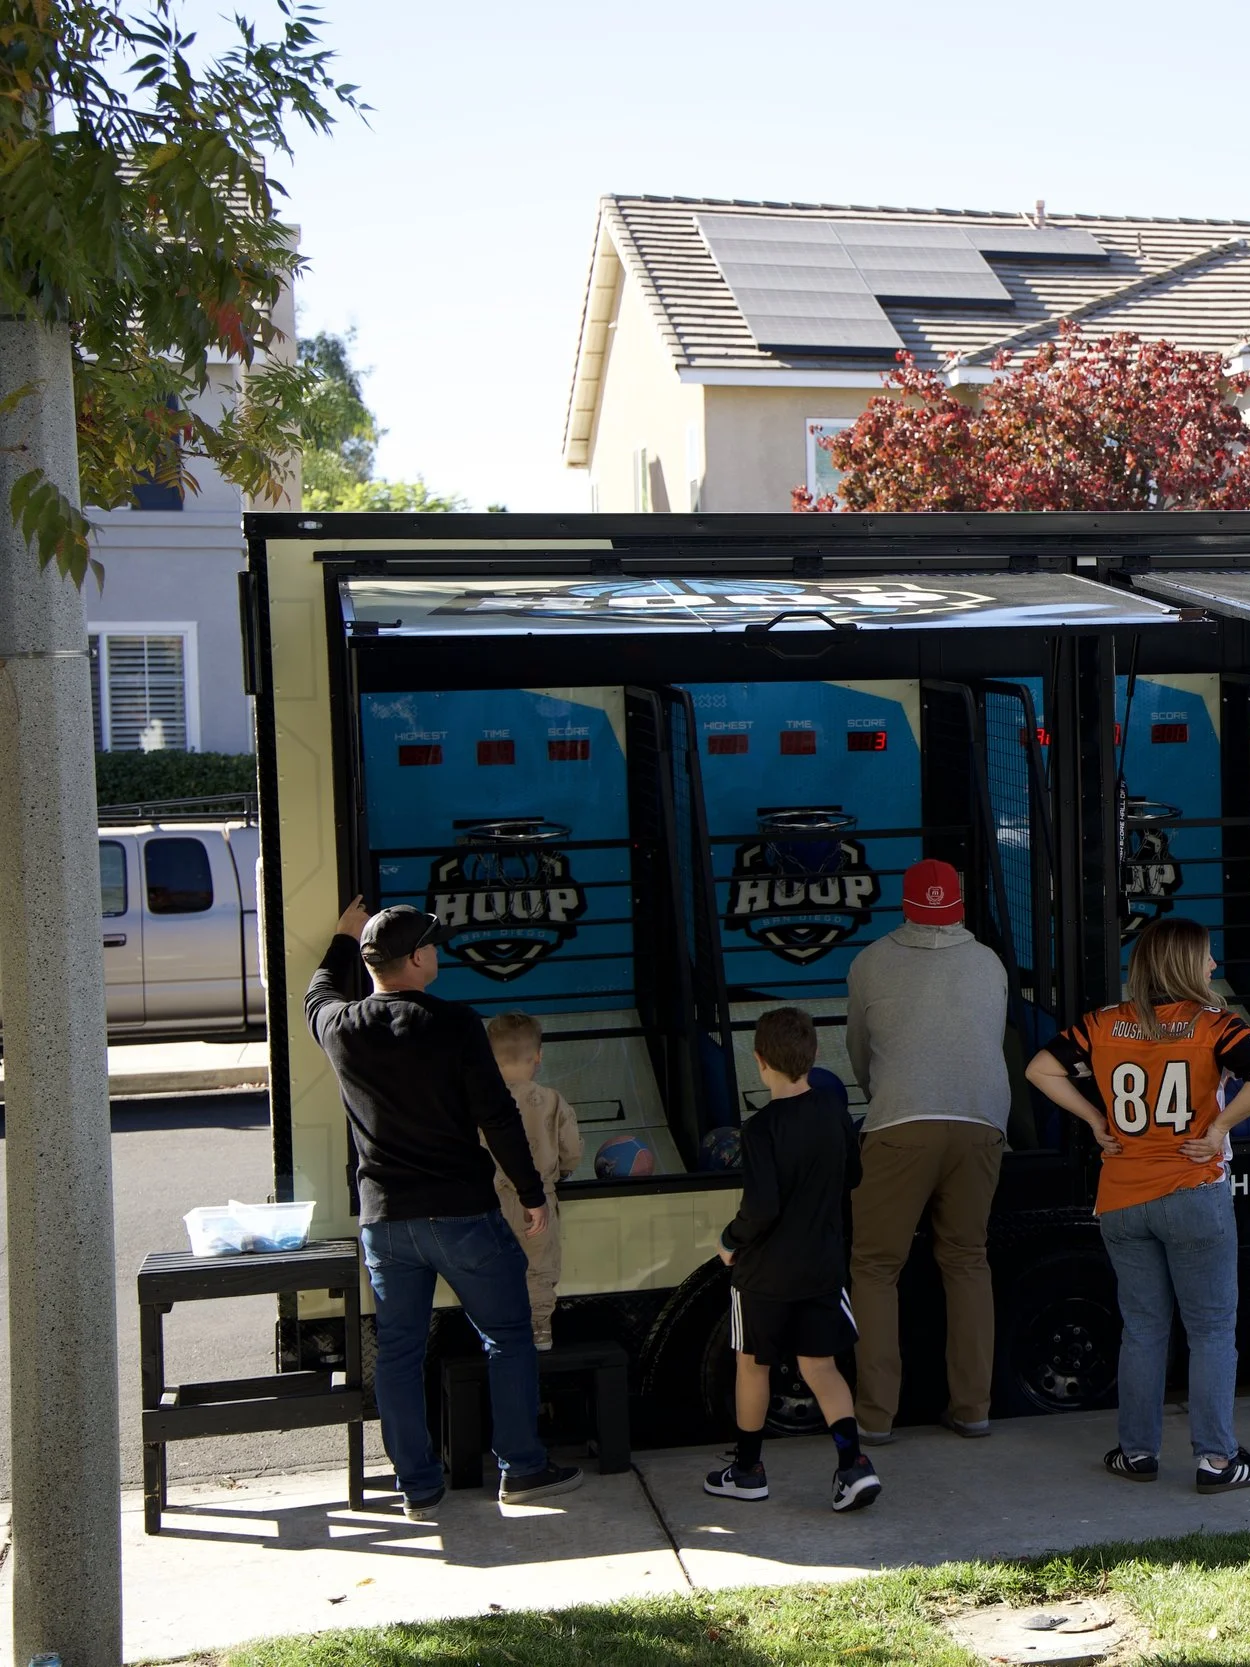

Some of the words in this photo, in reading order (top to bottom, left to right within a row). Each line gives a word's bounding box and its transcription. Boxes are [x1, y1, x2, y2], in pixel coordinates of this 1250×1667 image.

[464, 591, 949, 611] HOOP
[1150, 711, 1188, 721] SCORE
[703, 720, 755, 731] HIGHEST
[785, 719, 813, 730] TIME
[847, 718, 888, 729] SCORE
[394, 730, 449, 742] HIGHEST
[481, 728, 512, 739] TIME
[547, 725, 590, 738] SCORE
[873, 732, 888, 750] 3
[734, 875, 874, 915] HOOP
[433, 887, 580, 928] HOOP
[760, 915, 791, 926] SAN
[799, 913, 843, 924] DIEGO
[460, 929, 492, 941] SAN
[499, 927, 546, 939] DIEGO
[1111, 1060, 1195, 1136] 84
